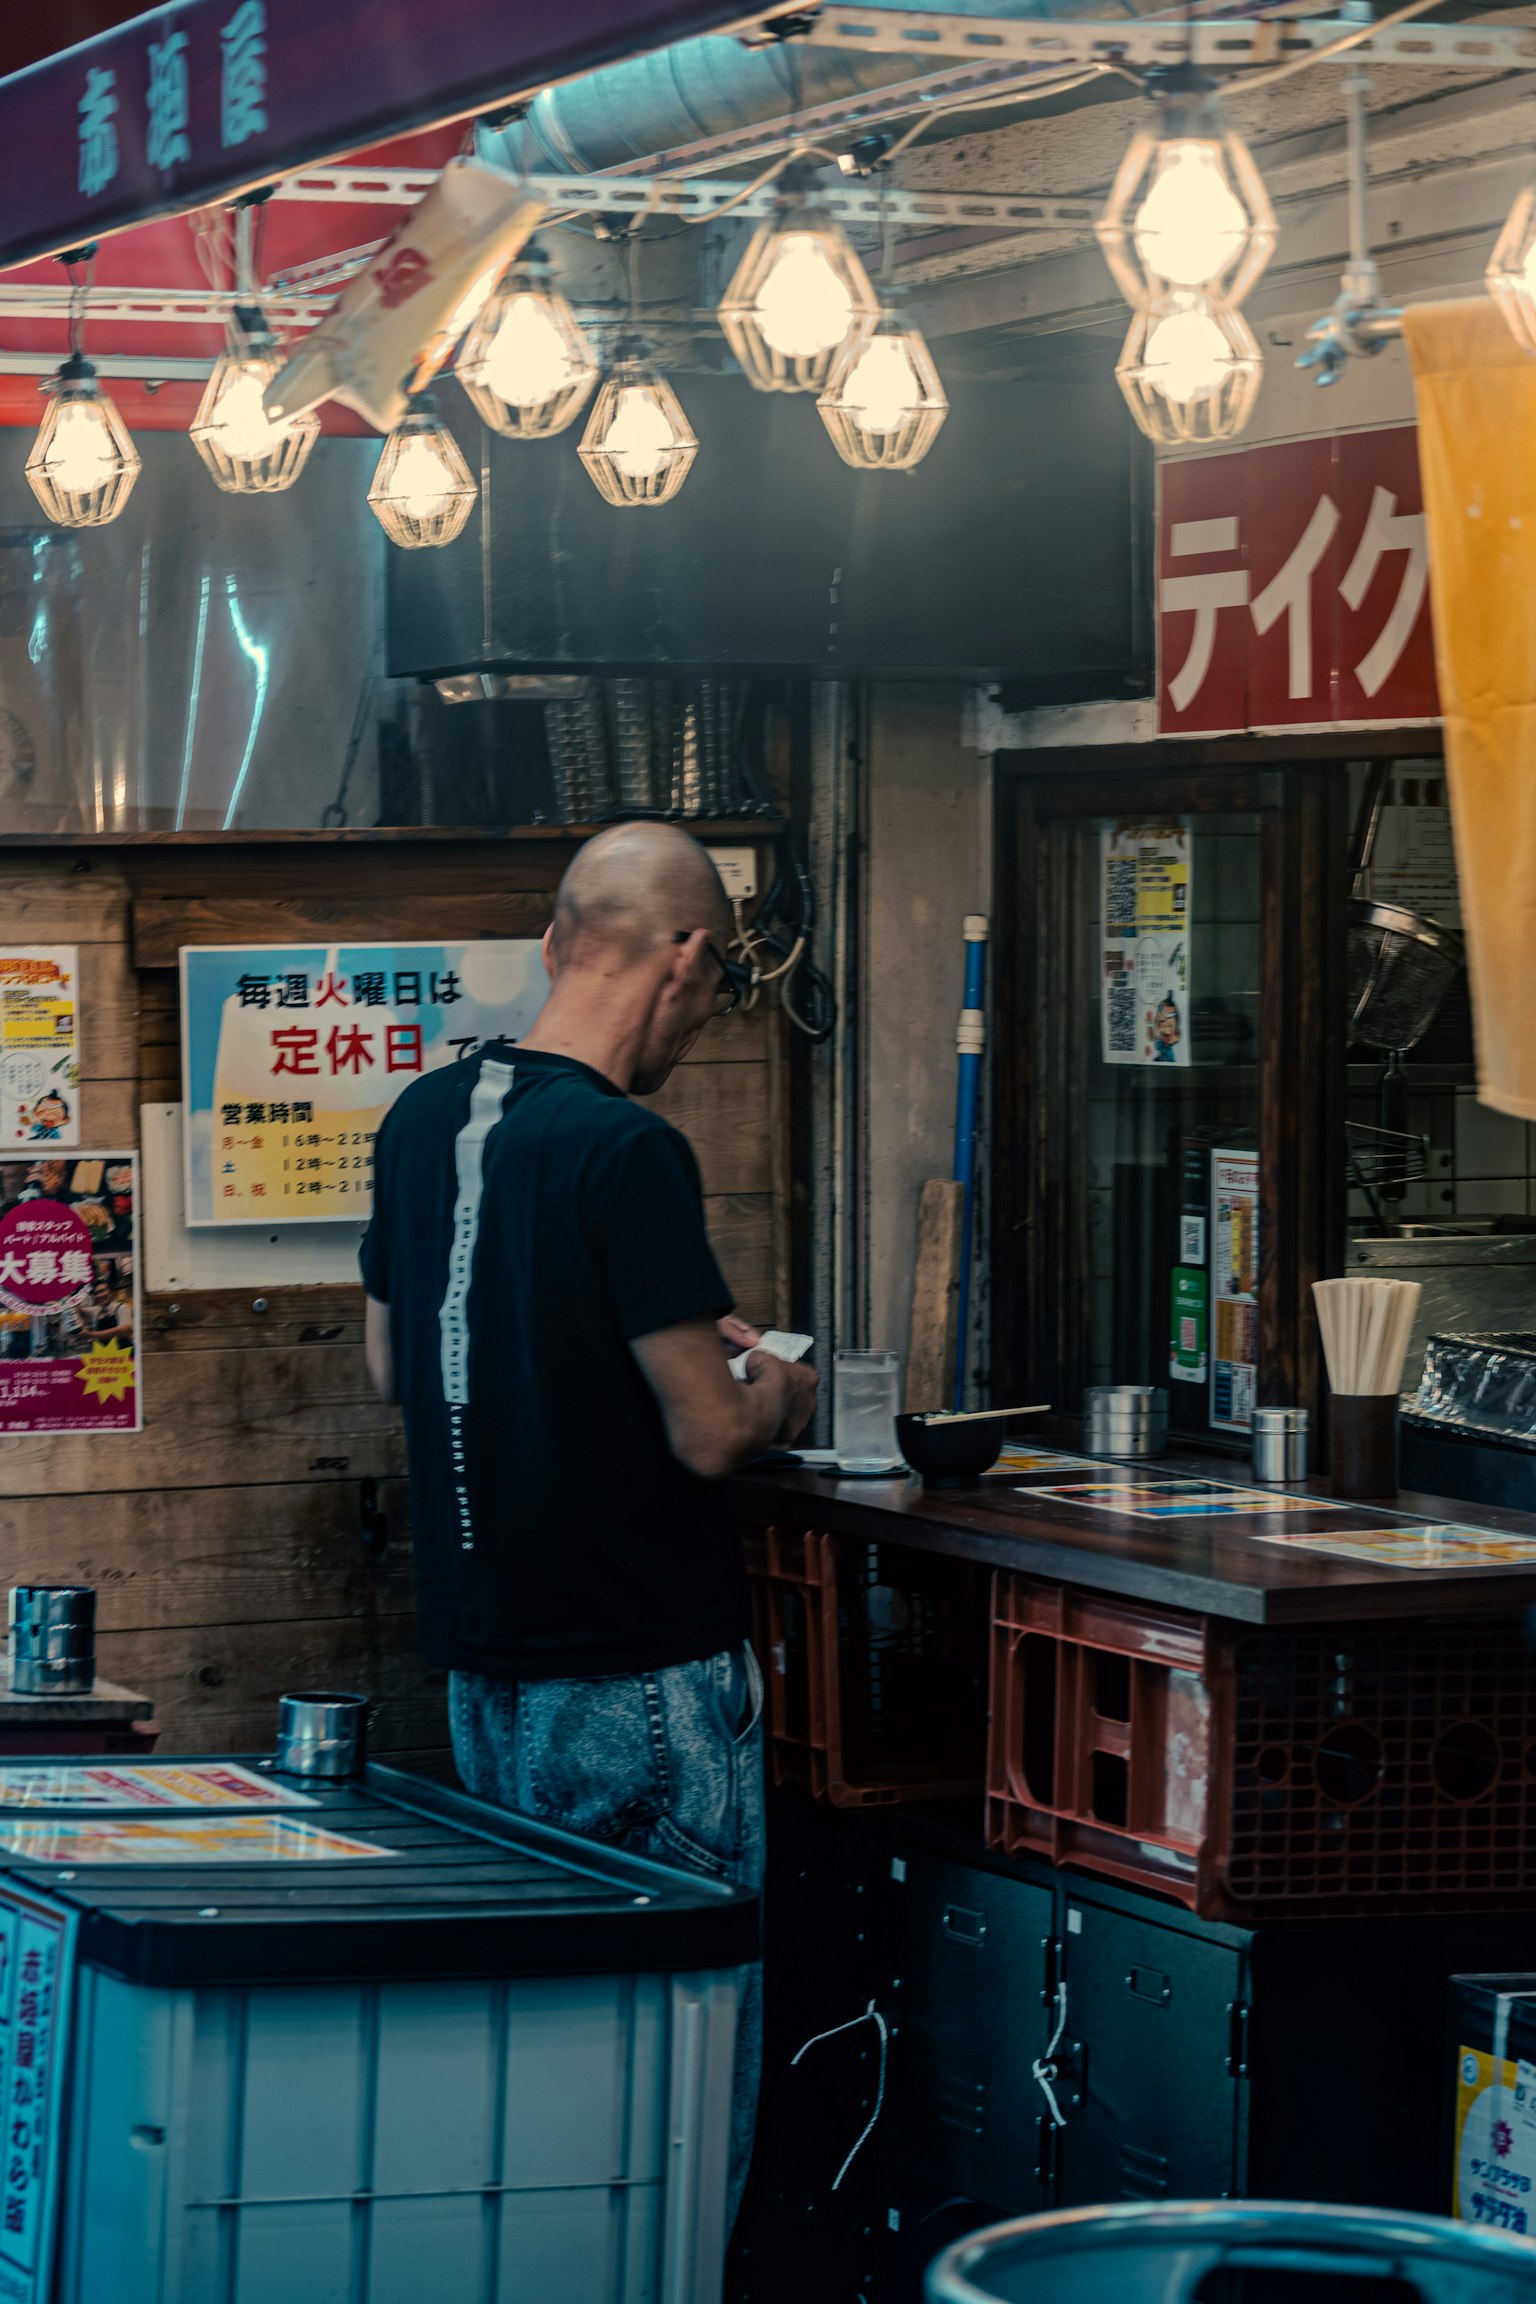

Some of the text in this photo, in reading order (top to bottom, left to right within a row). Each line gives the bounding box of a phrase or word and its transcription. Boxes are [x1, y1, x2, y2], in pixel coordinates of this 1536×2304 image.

[1158, 484, 1428, 713] ティク
[237, 968, 462, 1010] 毎週火曜日は
[270, 1023, 425, 1077] 定休日
[221, 1101, 315, 1126] 営業時間
[221, 1160, 237, 1174] 土
[0, 1250, 94, 1286] 大募集
[450, 1403, 466, 1474] LUXURY
[455, 1485, 474, 1550] SPORTS
